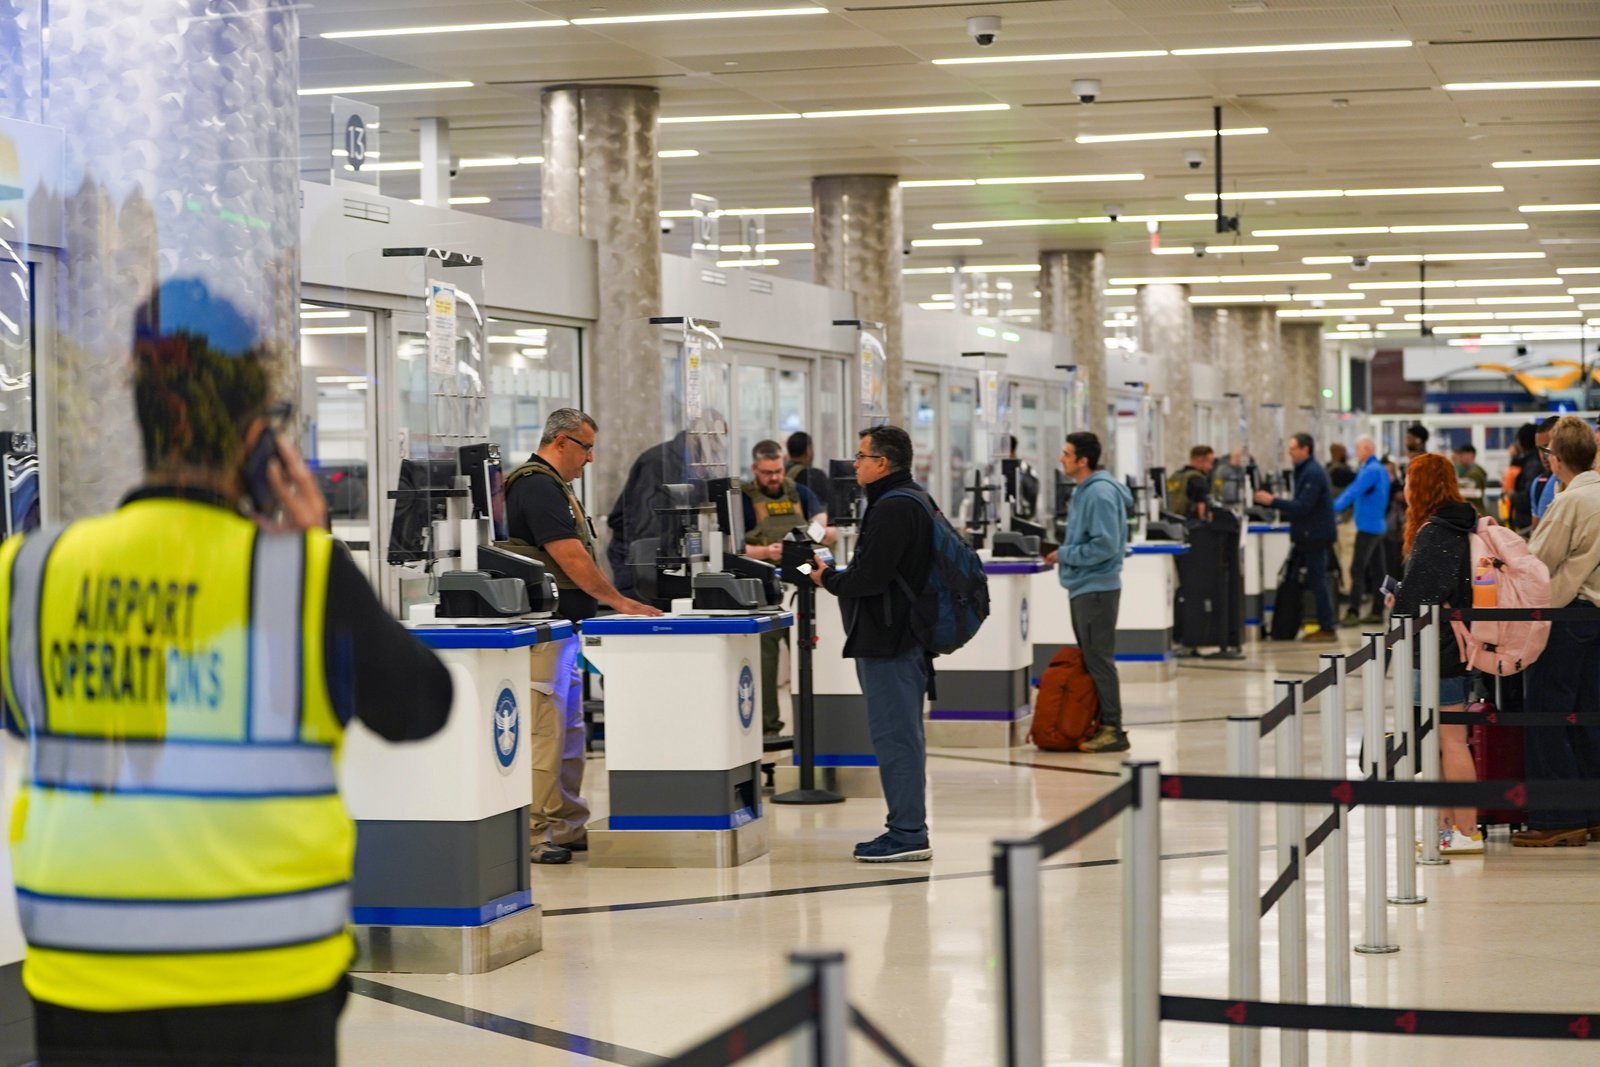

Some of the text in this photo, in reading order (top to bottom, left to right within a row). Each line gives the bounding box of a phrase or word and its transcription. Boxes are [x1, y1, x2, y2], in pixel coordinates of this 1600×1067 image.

[348, 126, 364, 160] 13
[74, 571, 198, 638] AIRPORT
[50, 641, 221, 709] OPERATIONS
